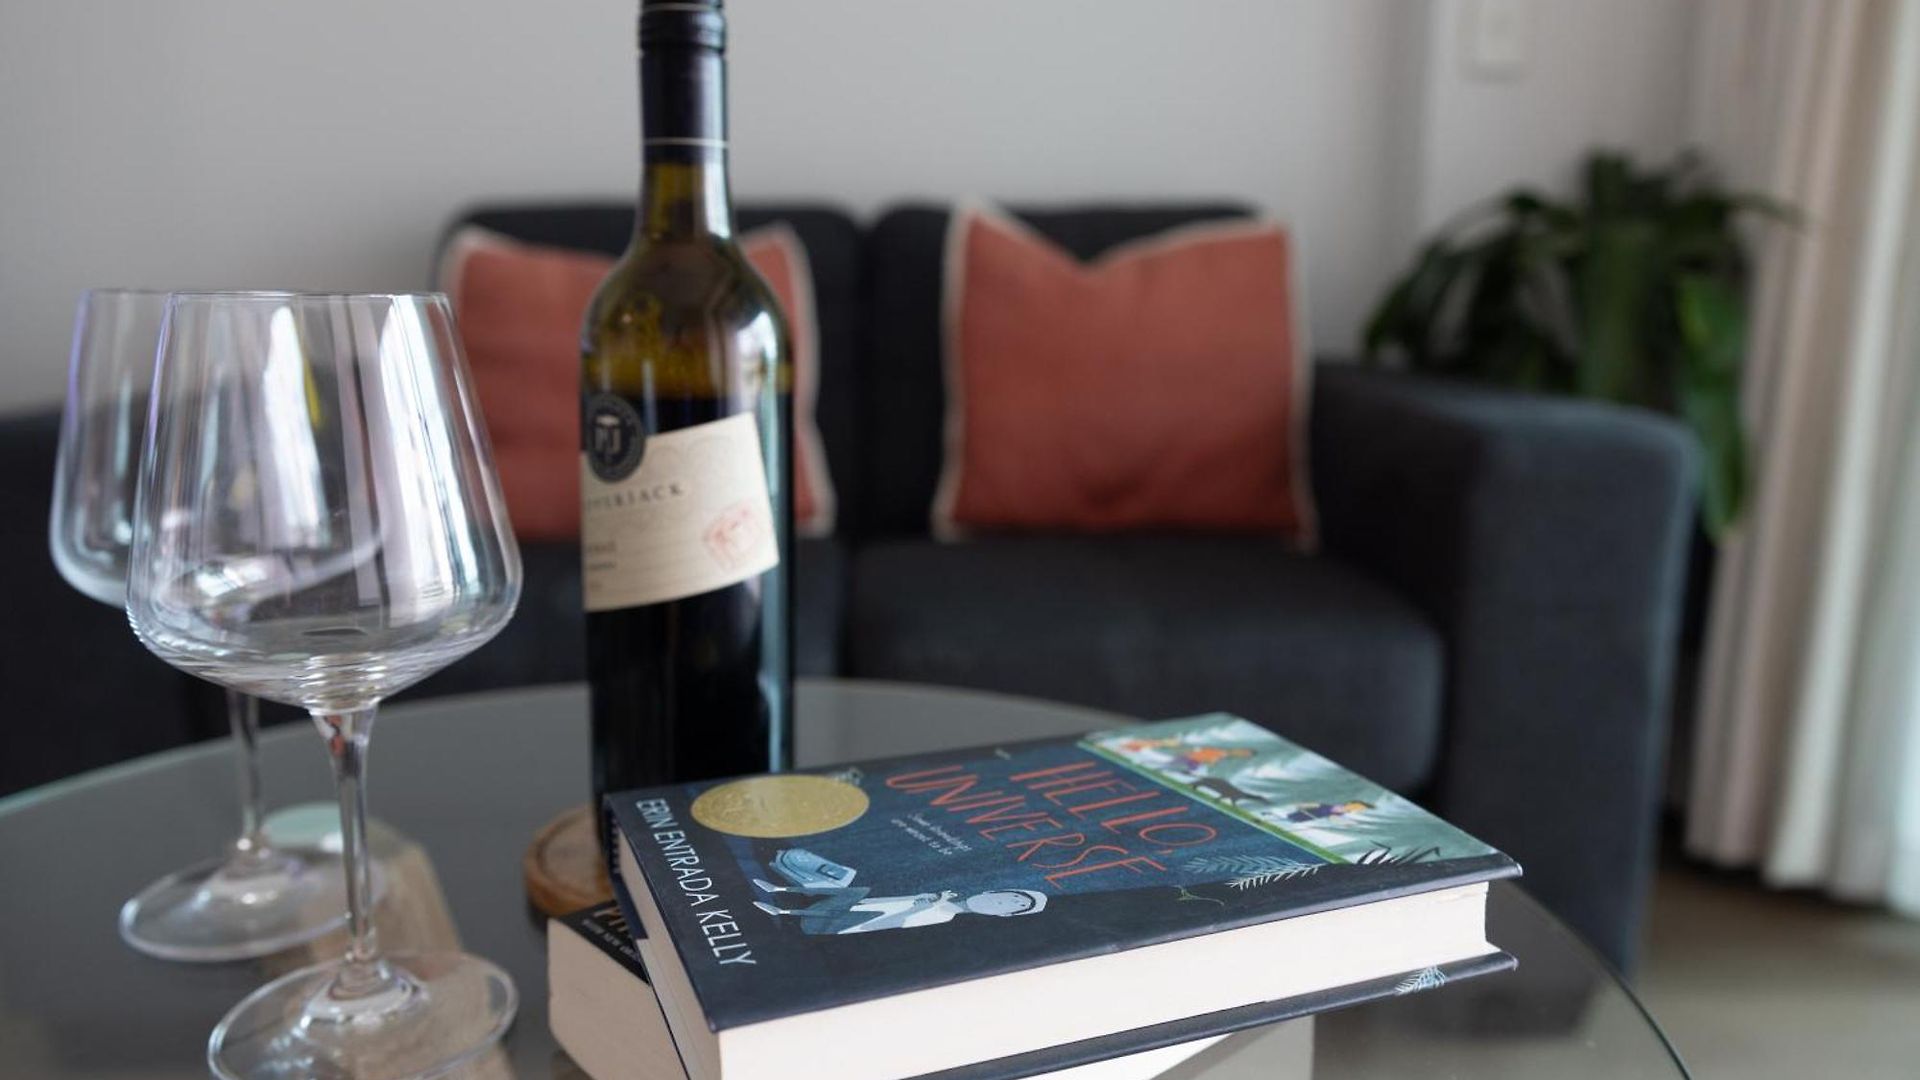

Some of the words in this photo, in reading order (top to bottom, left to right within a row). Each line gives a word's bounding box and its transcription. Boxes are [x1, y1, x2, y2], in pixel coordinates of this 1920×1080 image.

[635, 798, 679, 829] ERIN
[885, 765, 1167, 889] UNIVERSE
[653, 830, 720, 907] ENTRADA
[695, 909, 757, 965] KELLY
